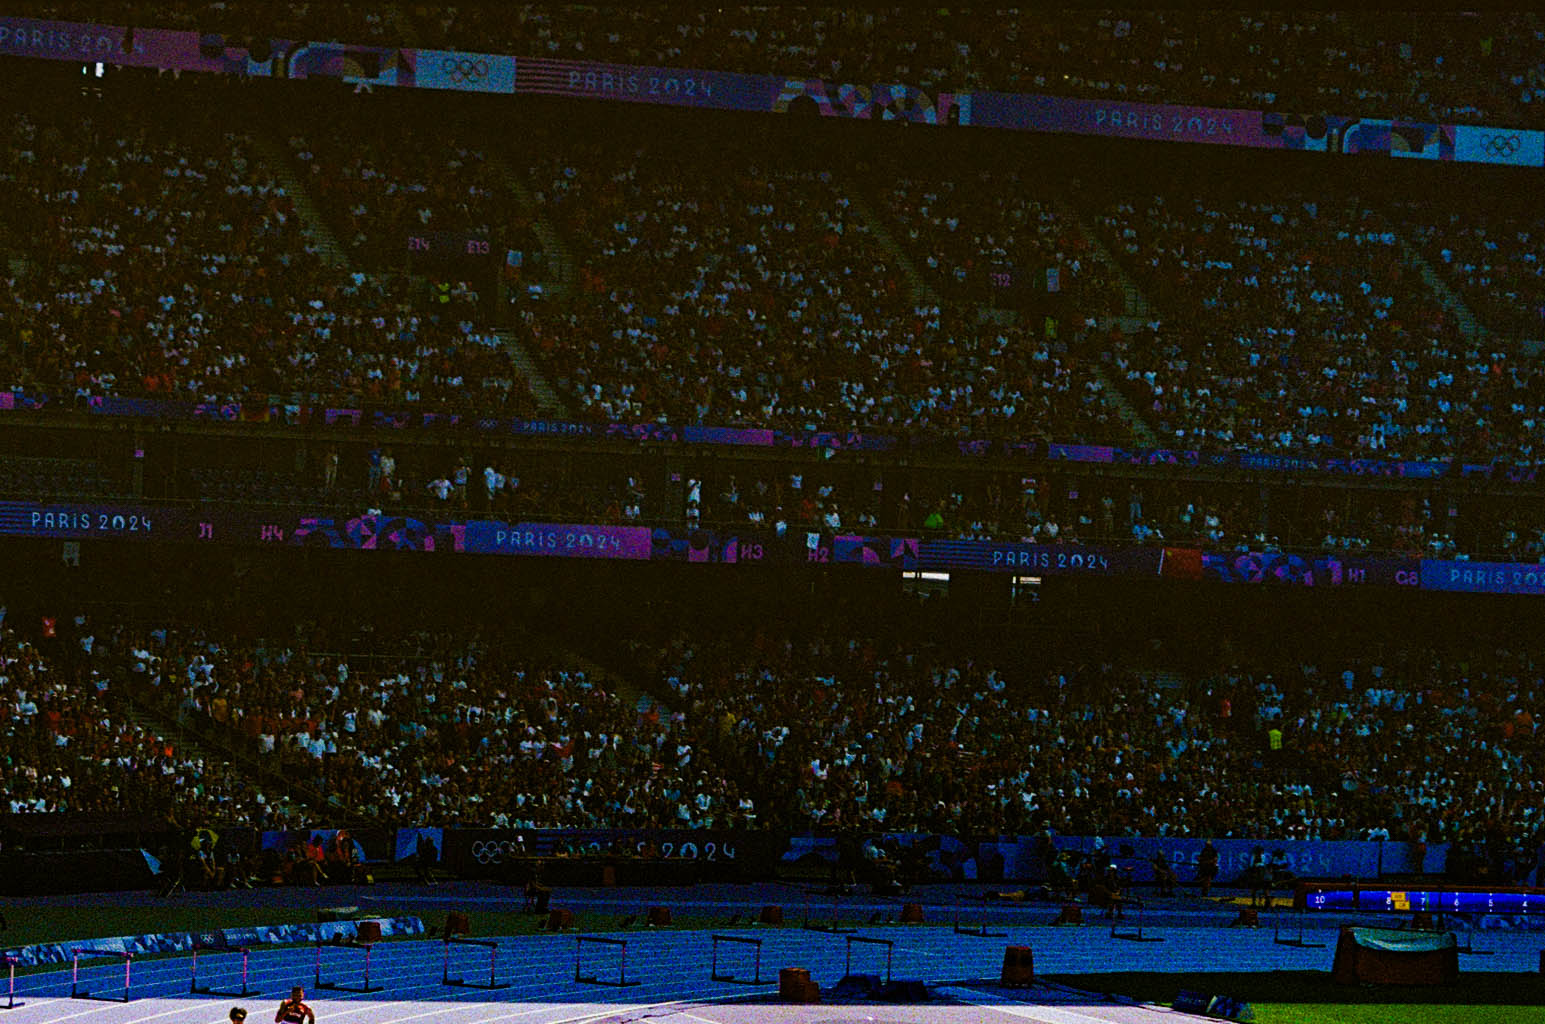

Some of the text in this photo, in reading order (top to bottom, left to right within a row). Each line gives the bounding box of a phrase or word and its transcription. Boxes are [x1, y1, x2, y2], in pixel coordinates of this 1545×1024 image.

[569, 70, 713, 97] PARIS 2024
[1096, 109, 1162, 131] PARIS
[31, 511, 152, 532] PARIS 2024
[496, 530, 621, 550] PARIS 2024
[740, 543, 765, 560] H3
[993, 550, 1110, 570] PARIS 2024
[1450, 568, 1506, 585] PARIS
[661, 841, 736, 863] 2024
[1314, 895, 1326, 904] 10
[1421, 897, 1426, 905] 7
